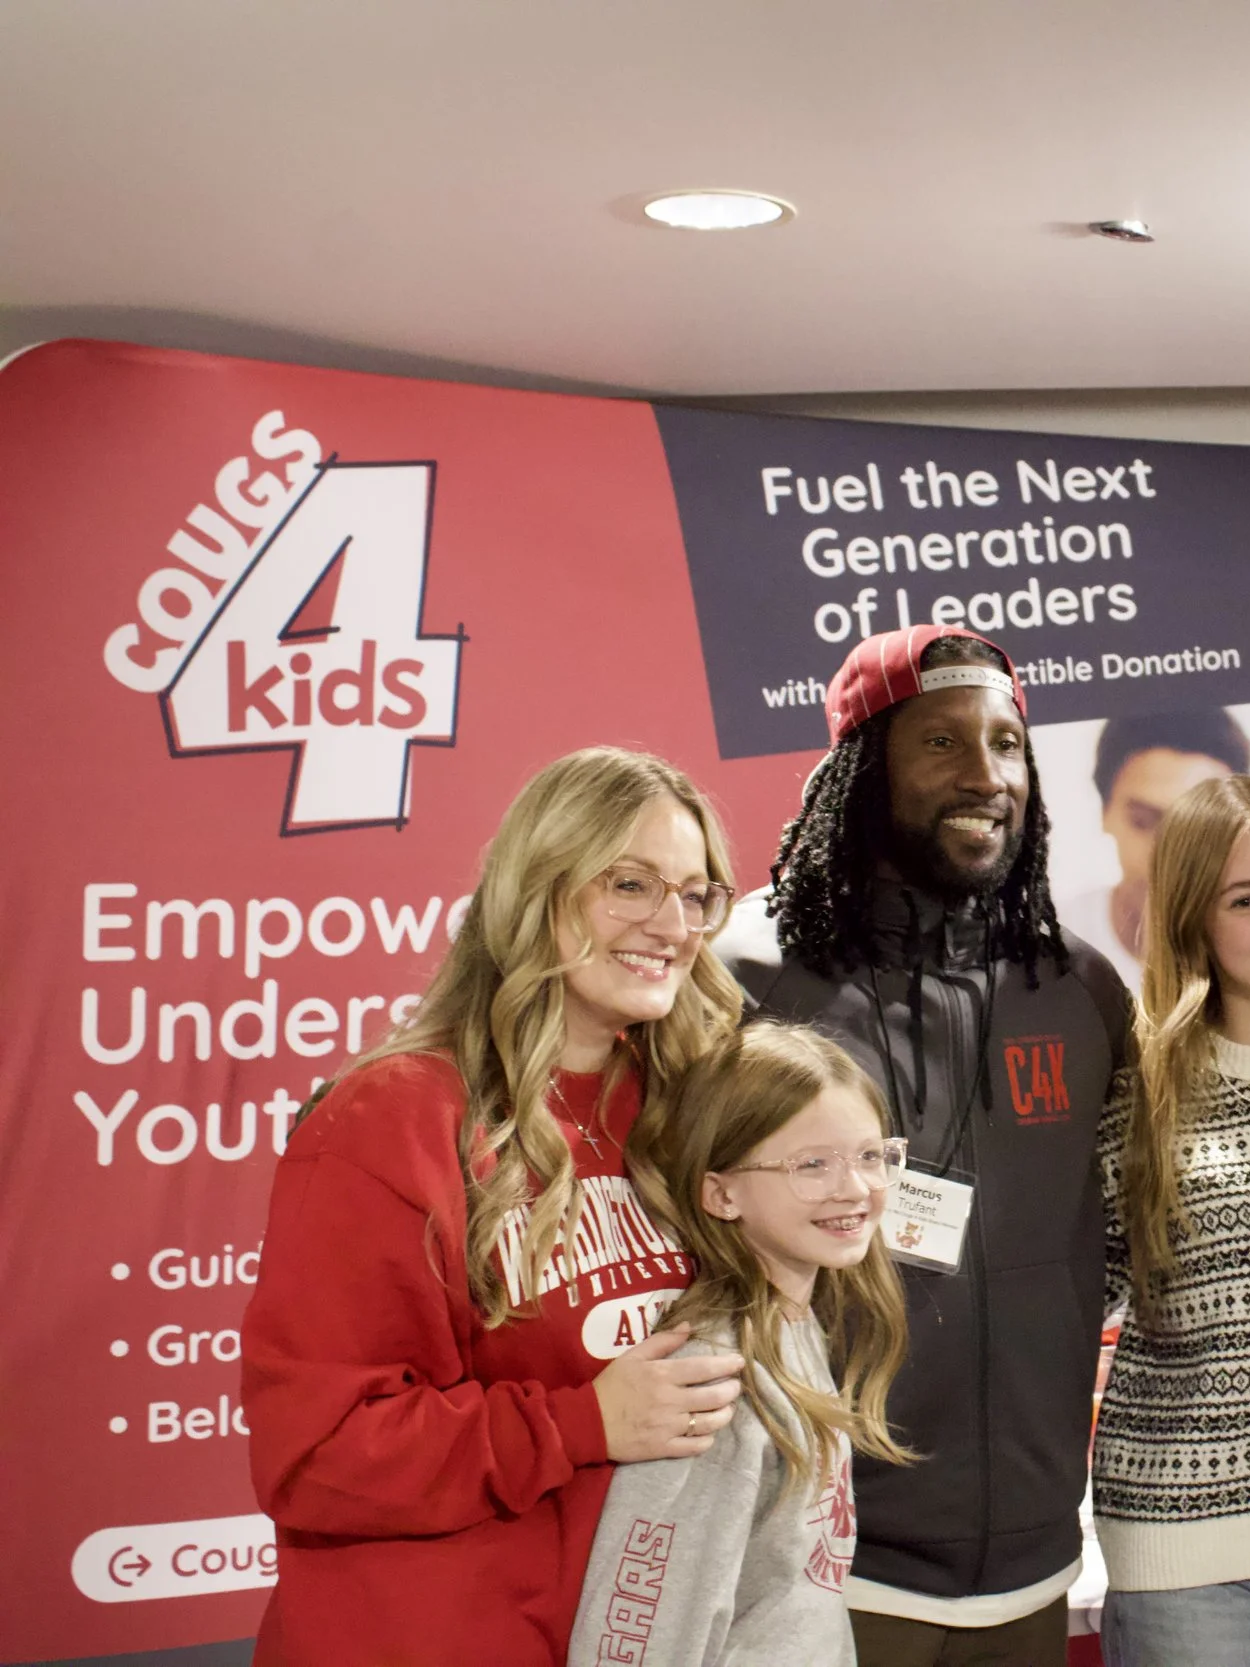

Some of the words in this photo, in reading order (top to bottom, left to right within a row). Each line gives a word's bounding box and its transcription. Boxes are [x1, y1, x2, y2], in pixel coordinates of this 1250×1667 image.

[761, 463, 884, 515] Fuel
[900, 461, 999, 508] the
[1016, 458, 1156, 504] Next
[103, 410, 322, 694] COUGS
[801, 518, 1133, 578] Generation
[814, 587, 878, 643] of
[896, 578, 1138, 633] Leaders
[158, 451, 468, 837] 4
[227, 639, 427, 733] kids
[762, 676, 826, 709] with
[1101, 645, 1241, 679] Donation
[1004, 1043, 1071, 1116] C4K
[73, 1077, 327, 1166] Yout
[898, 1196, 937, 1217] Trufant
[899, 1181, 943, 1201] Marcus
[171, 1542, 278, 1578] Coug
